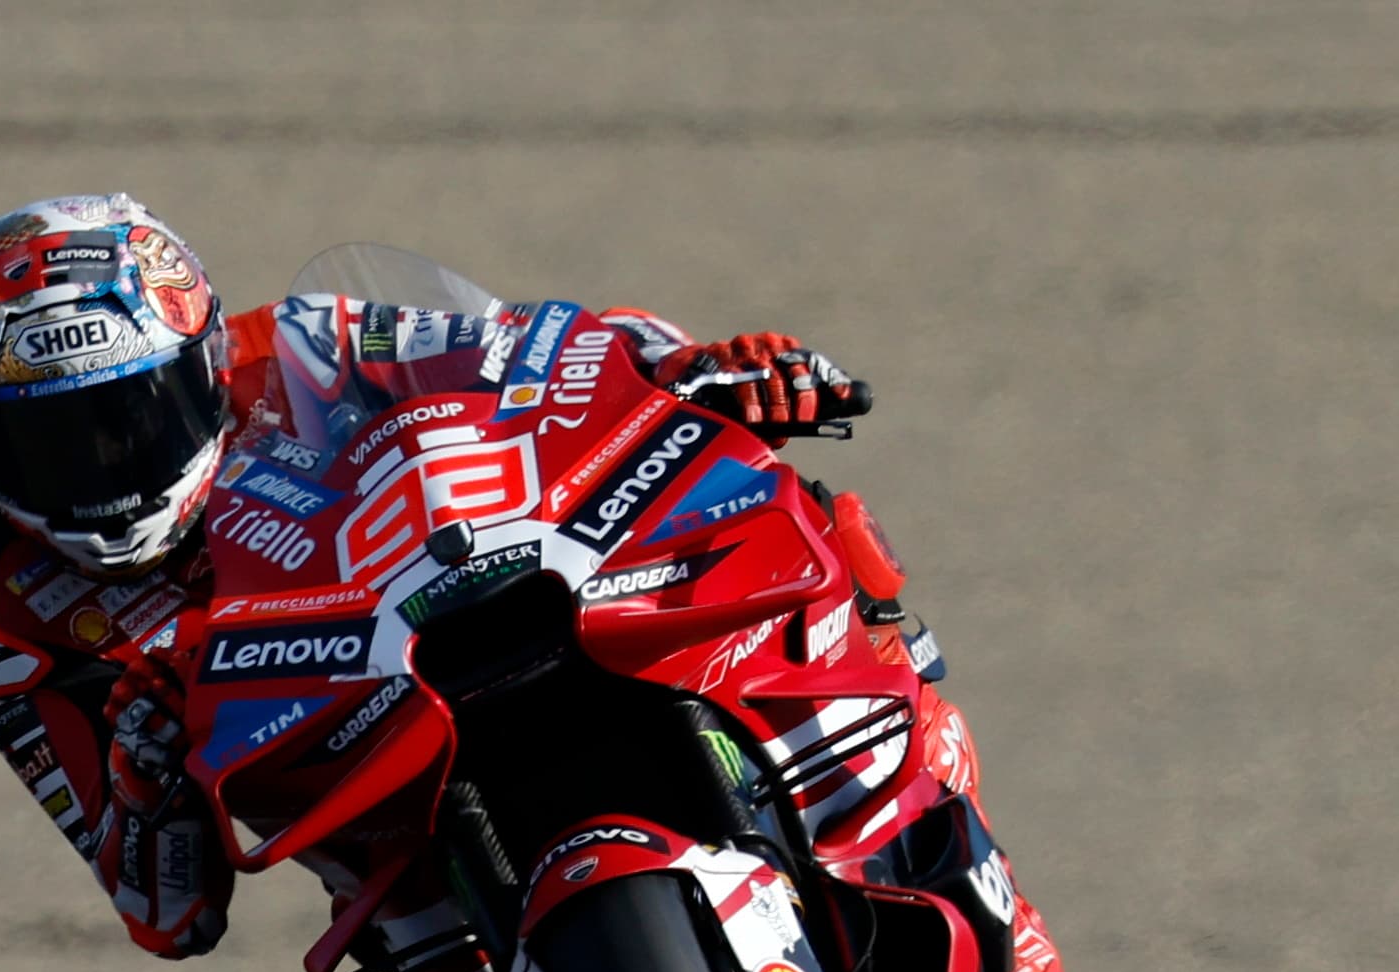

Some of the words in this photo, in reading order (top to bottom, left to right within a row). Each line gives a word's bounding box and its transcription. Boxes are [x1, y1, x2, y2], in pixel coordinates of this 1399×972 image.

[47, 248, 110, 262] Lenovo
[26, 320, 109, 359] SHOEI
[479, 329, 517, 384] WRS
[526, 304, 572, 375] ADVANCE
[76, 369, 119, 388] Galicia
[549, 331, 615, 405] riello
[348, 402, 466, 465] VARGROUP
[571, 398, 668, 487] FRECCIAROSSA
[270, 441, 321, 470] WRS
[241, 472, 325, 515] ADVANCE
[572, 421, 703, 542] Lenovo
[706, 490, 768, 519] TIM
[228, 510, 317, 572] riello
[427, 545, 539, 598] MONSTER
[581, 561, 689, 600] CARRERA
[252, 588, 367, 612] FRECCIAROSSA
[211, 635, 362, 671] Lenovo
[249, 702, 306, 745] TIM
[328, 676, 410, 751] CARRERA
